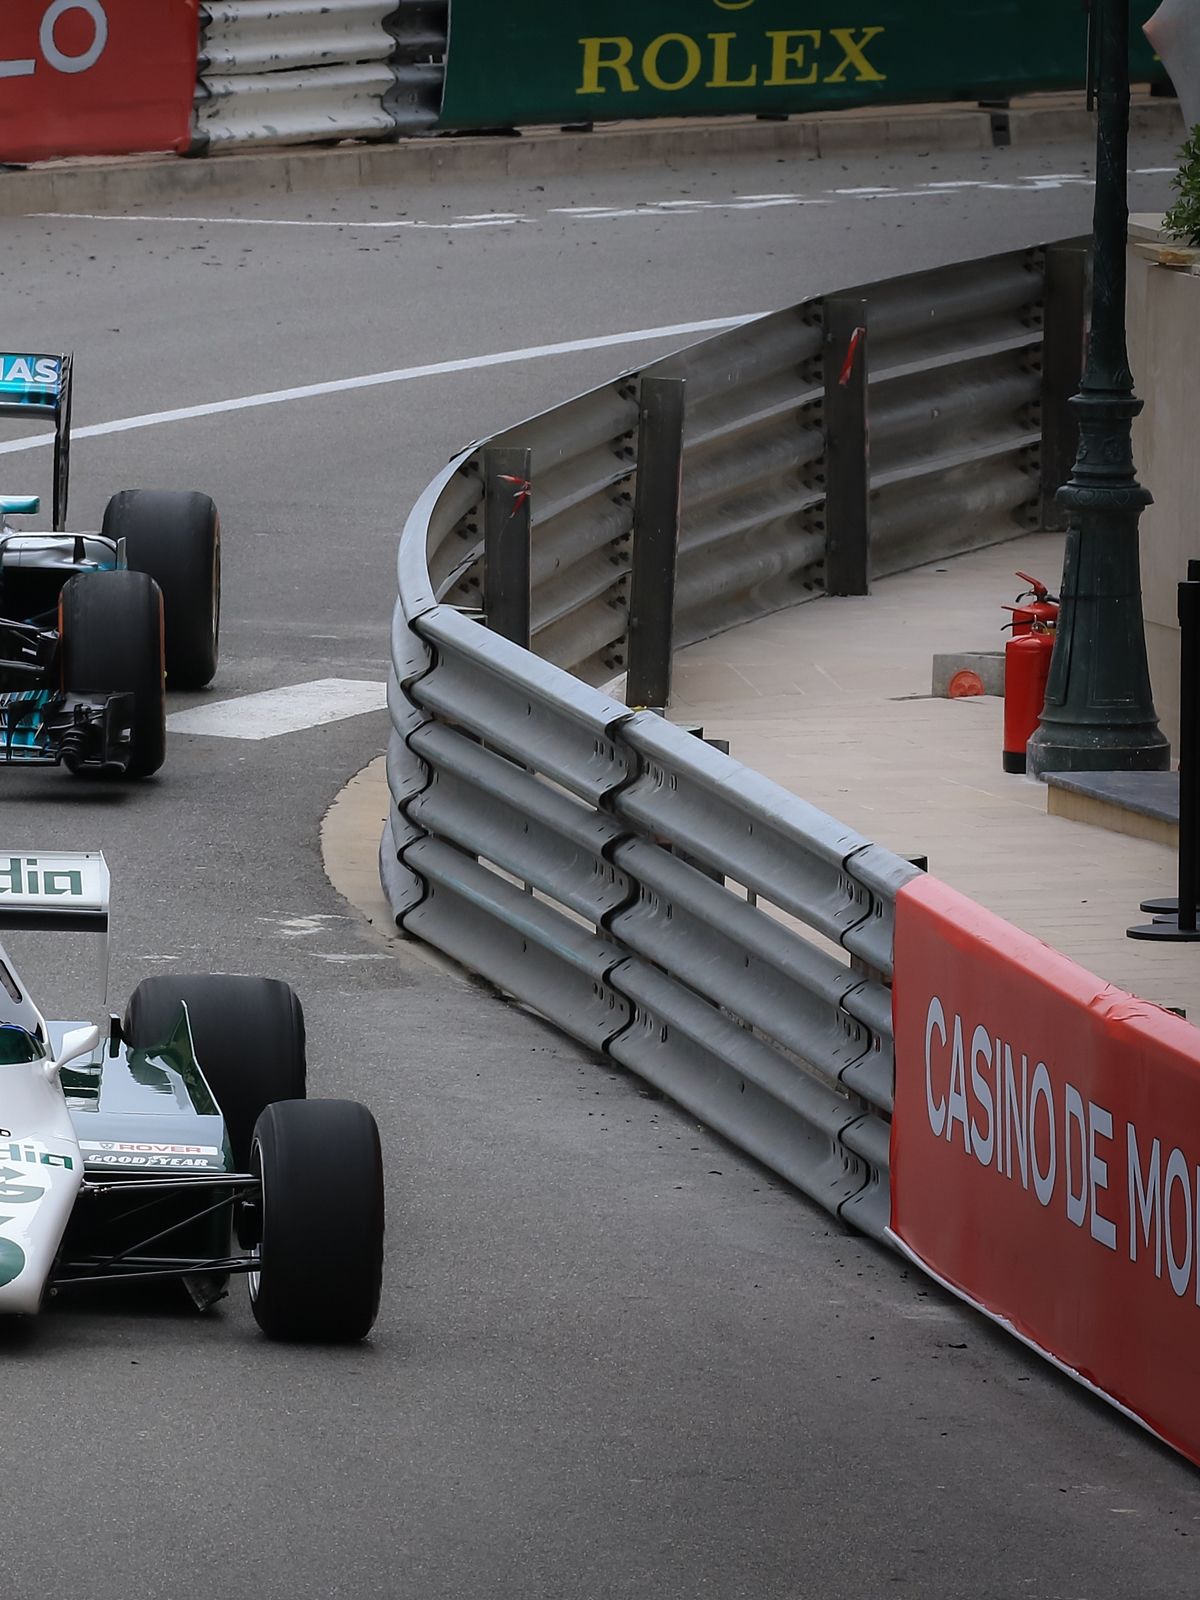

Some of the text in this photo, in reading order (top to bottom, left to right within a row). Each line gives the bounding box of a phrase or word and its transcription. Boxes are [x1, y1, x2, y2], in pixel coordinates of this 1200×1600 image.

[576, 26, 887, 94] ROLEX
[88, 1154, 209, 1167] GOODYEAR
[119, 1143, 201, 1153] ROVER
[925, 996, 1200, 1307] CASINO DE MO
